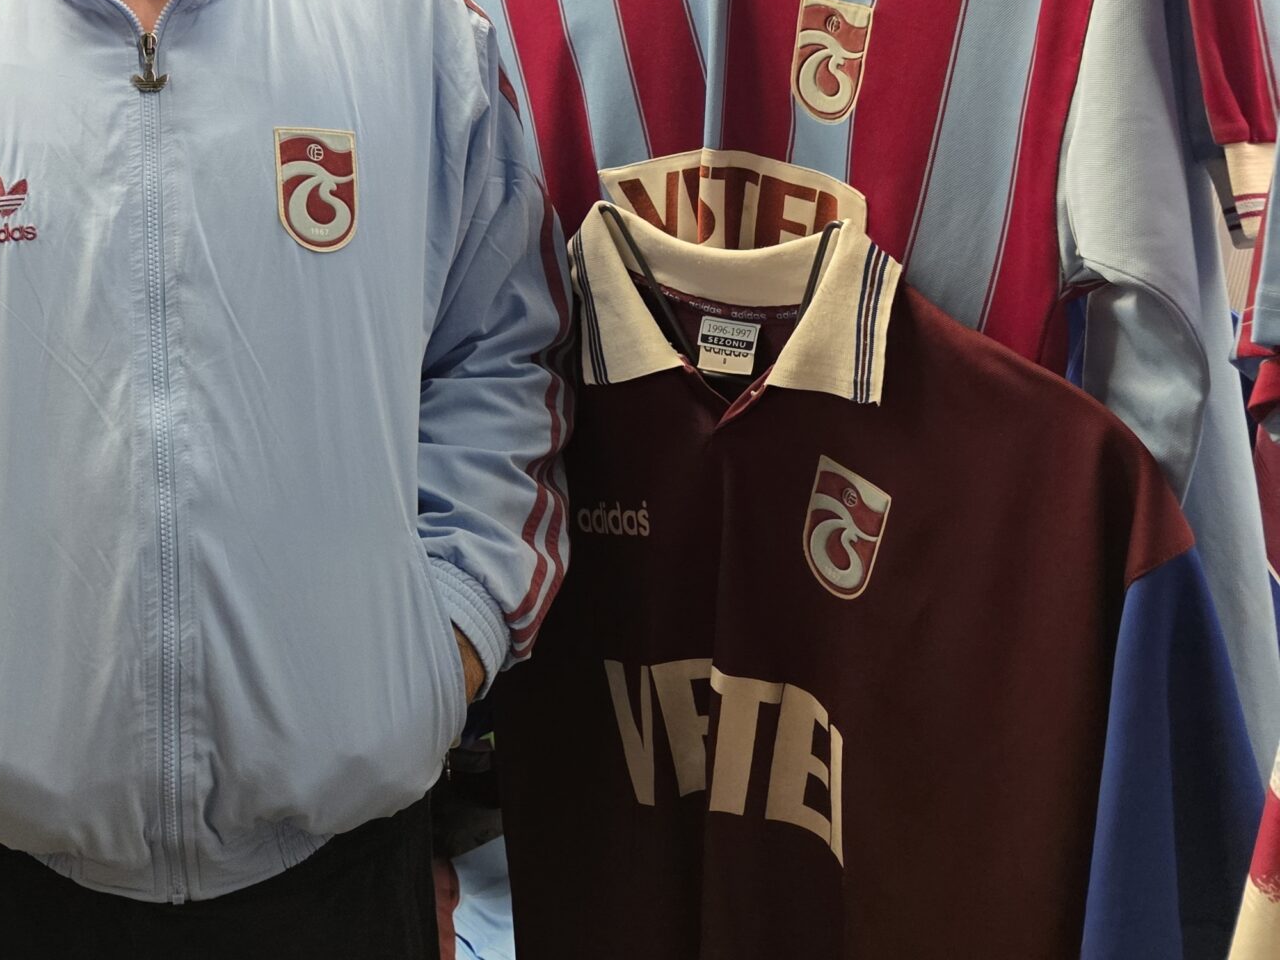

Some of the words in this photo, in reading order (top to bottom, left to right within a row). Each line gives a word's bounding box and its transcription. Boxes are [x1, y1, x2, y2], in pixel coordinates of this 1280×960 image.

[731, 308, 767, 321] adidas
[706, 323, 752, 339] 1996-1997
[707, 335, 747, 349] SEZONU
[577, 499, 651, 537] adidas
